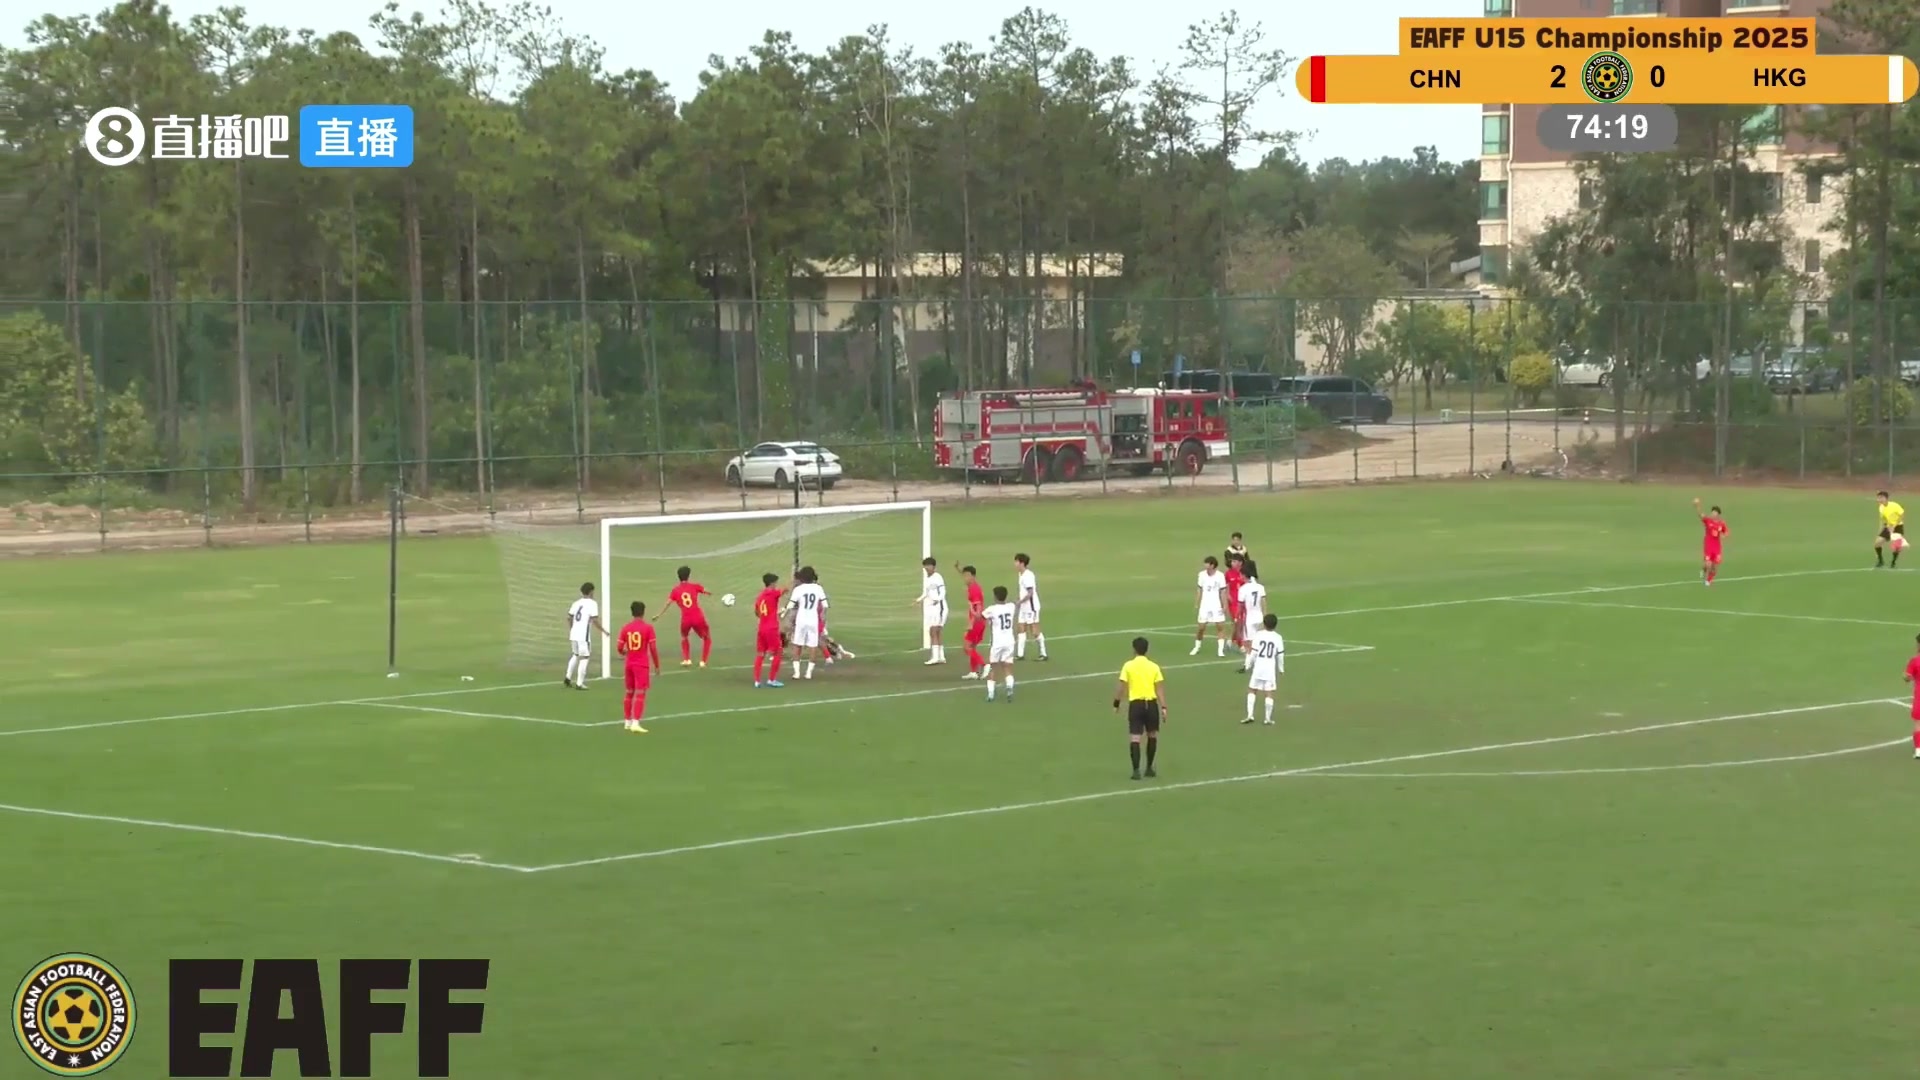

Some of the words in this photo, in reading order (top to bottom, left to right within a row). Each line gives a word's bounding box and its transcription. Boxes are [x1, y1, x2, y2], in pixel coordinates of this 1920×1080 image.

[680, 592, 693, 609] 8
[803, 593, 816, 610] 19
[1251, 591, 1259, 607] 7
[575, 605, 583, 622] 6
[759, 601, 768, 617] 4
[998, 613, 1011, 630] 15
[627, 631, 642, 651] 19
[1259, 640, 1275, 658] 20
